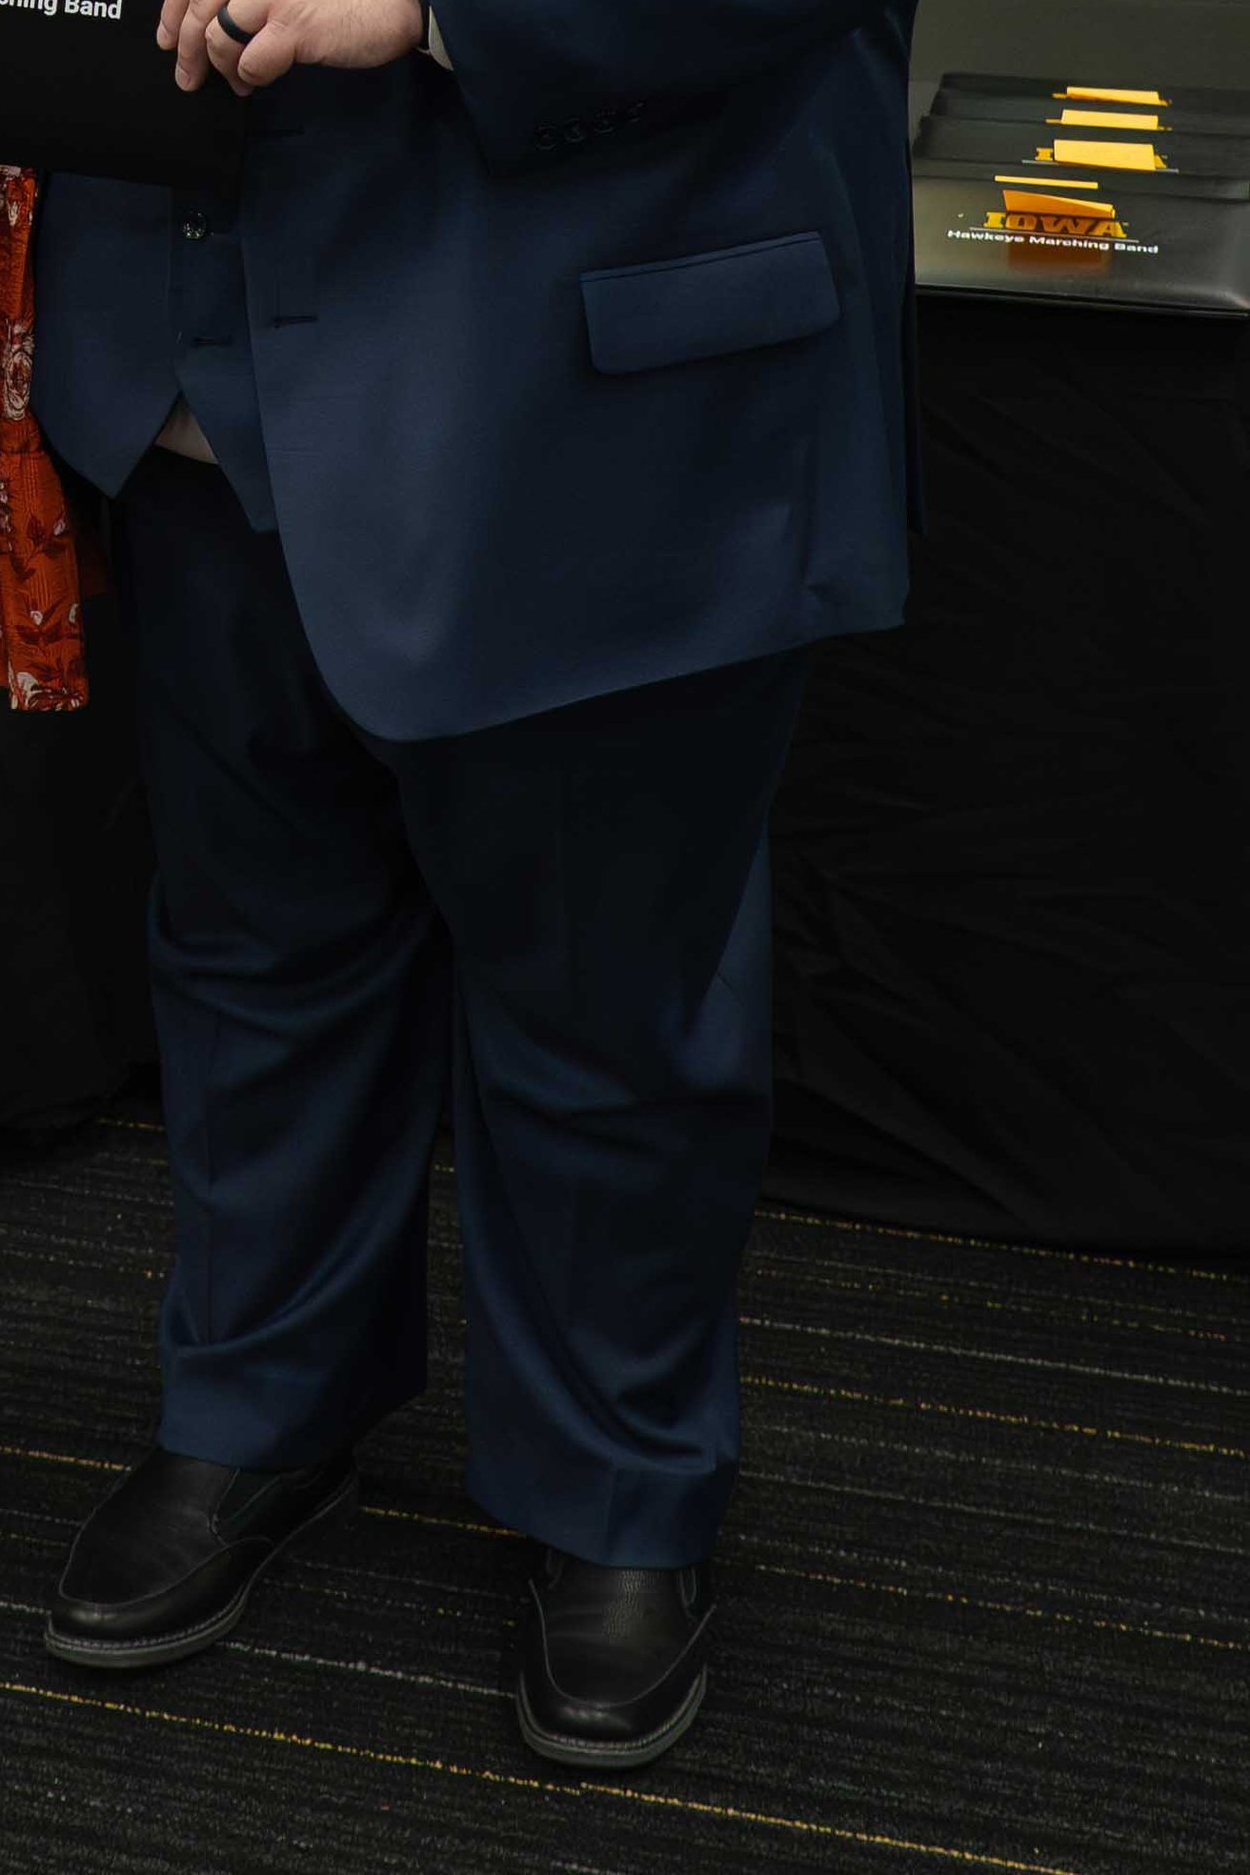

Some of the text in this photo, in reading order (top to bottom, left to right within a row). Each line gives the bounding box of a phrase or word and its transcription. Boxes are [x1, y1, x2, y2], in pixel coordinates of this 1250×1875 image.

[947, 230, 1159, 254] Hawkeye Marching Band
